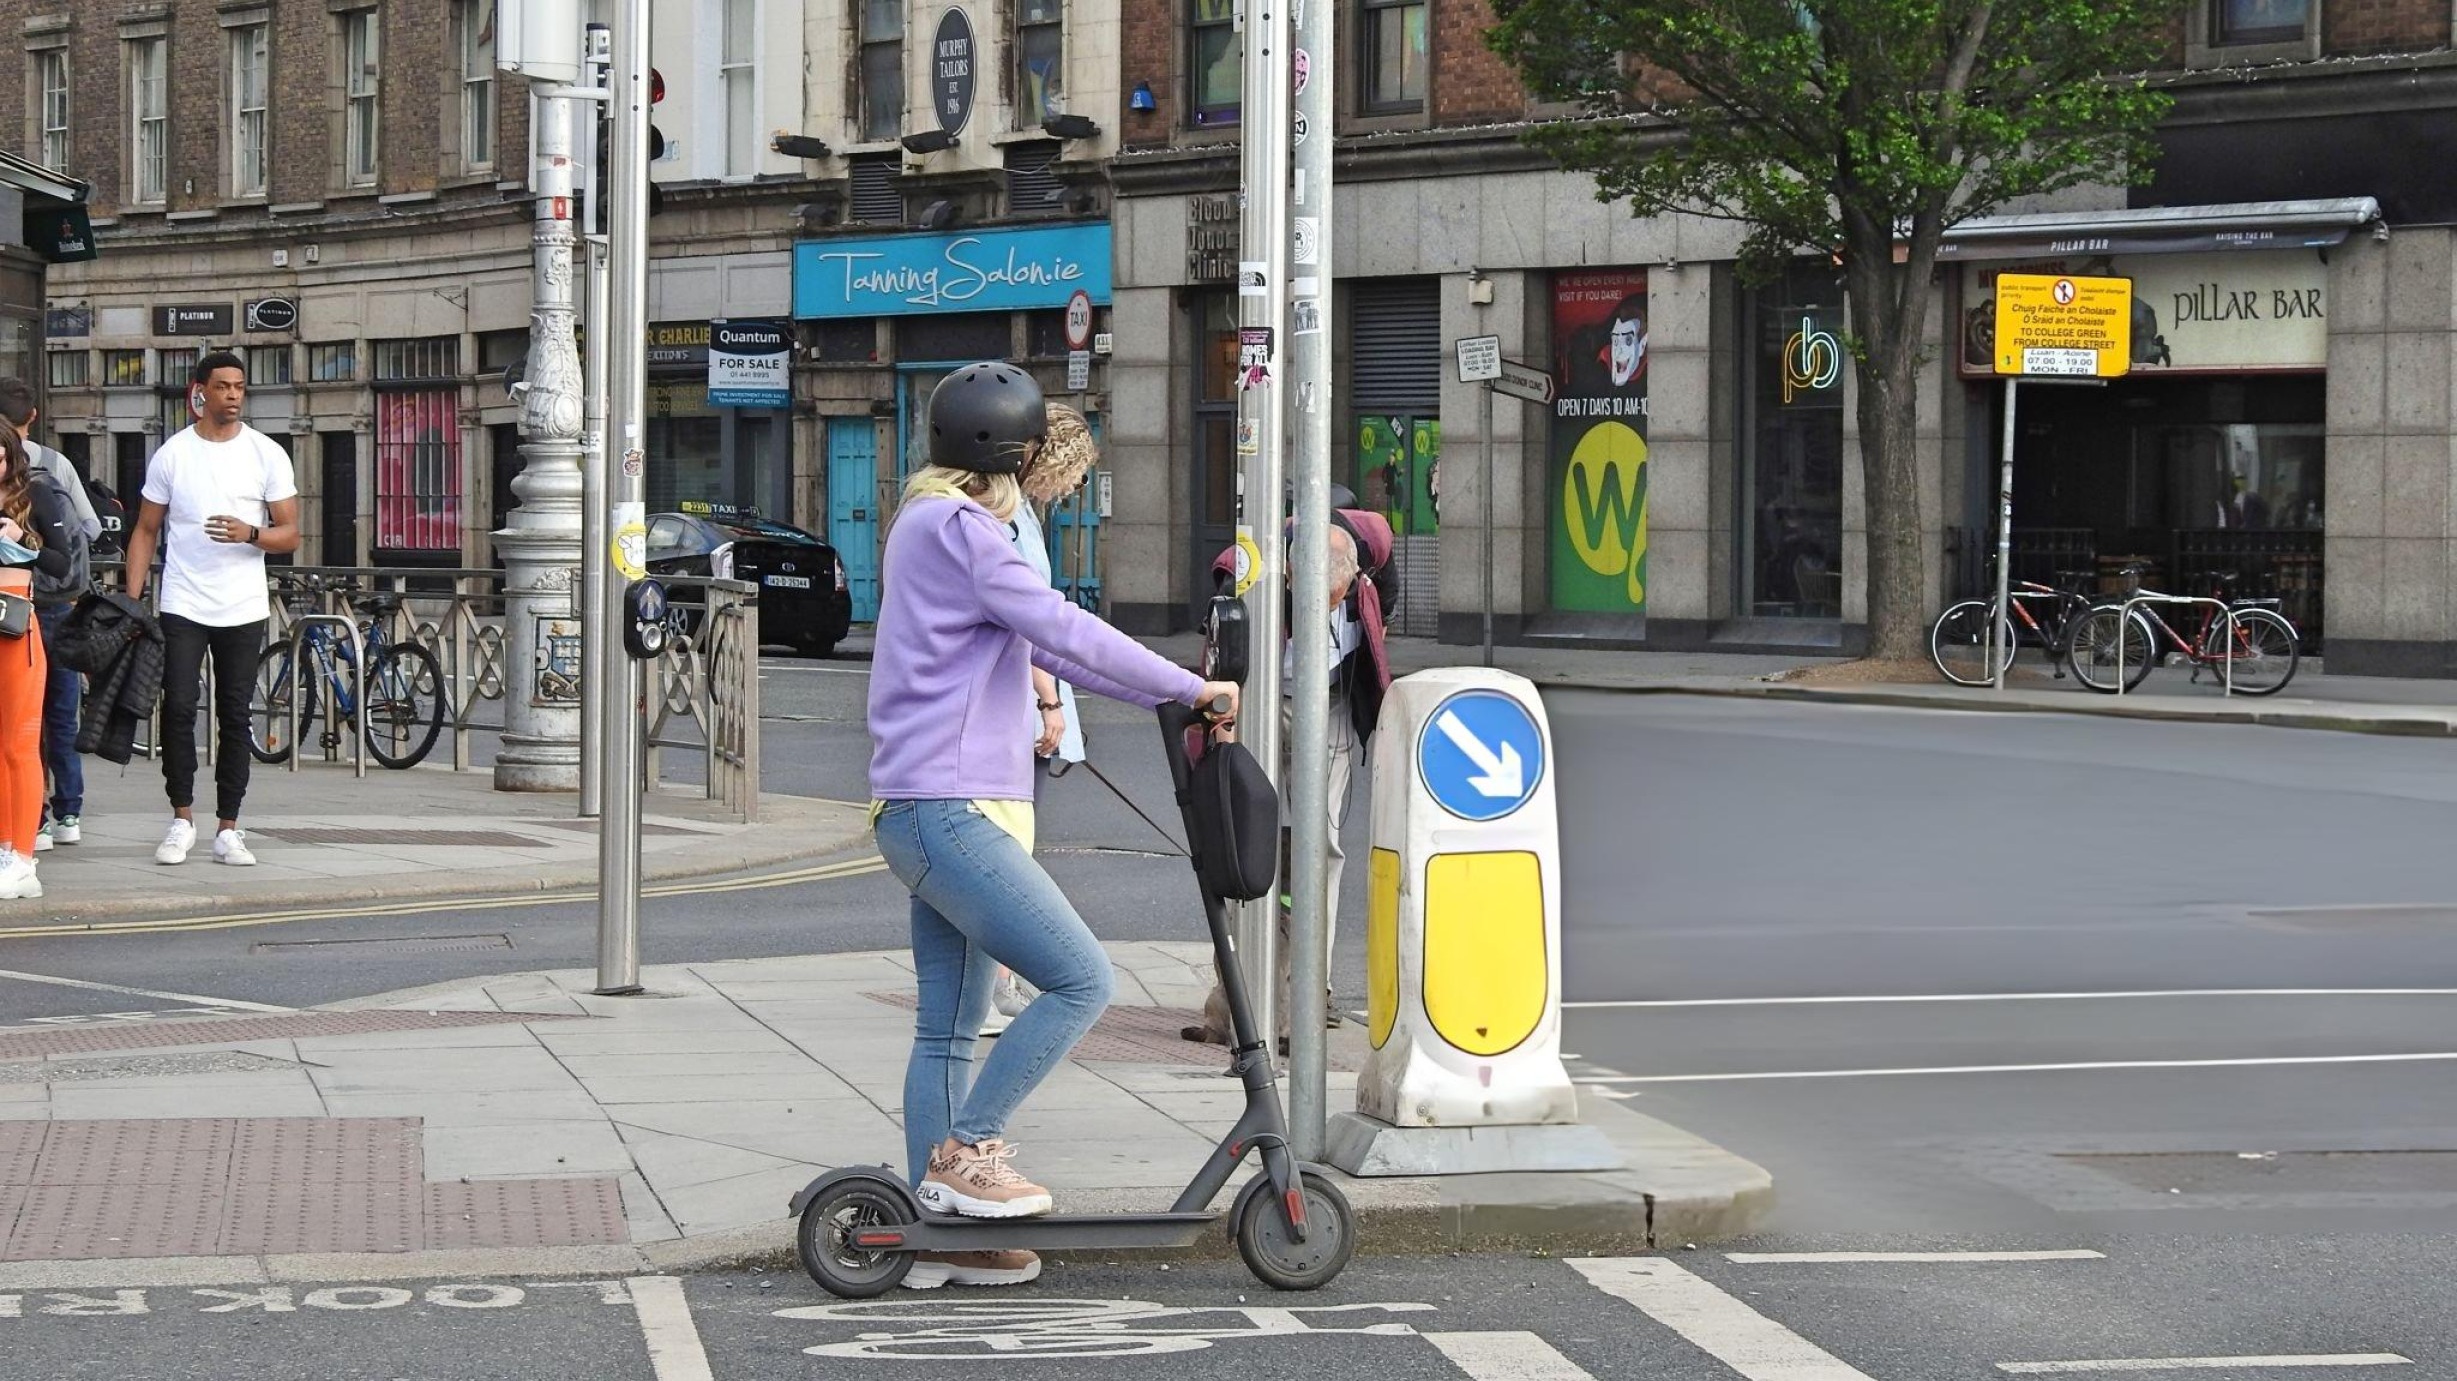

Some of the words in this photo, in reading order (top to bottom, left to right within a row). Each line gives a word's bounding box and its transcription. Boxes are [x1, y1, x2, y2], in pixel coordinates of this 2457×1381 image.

[939, 38, 968, 57] MURPHY
[939, 59, 969, 78] TAILORS
[1190, 196, 1231, 221] Blood
[2050, 240, 2085, 252] PILLAR
[2088, 239, 2109, 250] BAR
[1187, 251, 1232, 279] Clinic
[1559, 291, 1573, 302] VISIT
[1585, 290, 1600, 301] YOU
[1601, 289, 1622, 300] DARE!
[2012, 304, 2036, 314] Chuig
[2038, 304, 2065, 313] Faiche
[2273, 286, 2325, 320] BAR
[1070, 311, 1088, 327] TAXI
[660, 327, 710, 345] CHARLIE
[719, 330, 780, 344] Quantum
[2020, 327, 2032, 336] TO
[2034, 327, 2075, 338] COLLEGE
[2076, 328, 2107, 338] GREEN
[1241, 345, 1268, 355] HOMES
[2013, 338, 2039, 348] FROM
[2041, 339, 2081, 349] COLLEGE
[2083, 340, 2116, 350] STREET
[719, 358, 745, 369] FOR
[748, 358, 780, 370] SALE
[2069, 367, 2089, 375] FRI
[1557, 398, 1581, 417] OPEN
[1583, 398, 1588, 416] 7
[1590, 397, 1611, 417] DAYS
[1613, 397, 1623, 416] 10
[711, 504, 735, 514] TAXI
[917, 1187, 940, 1201] FILA
